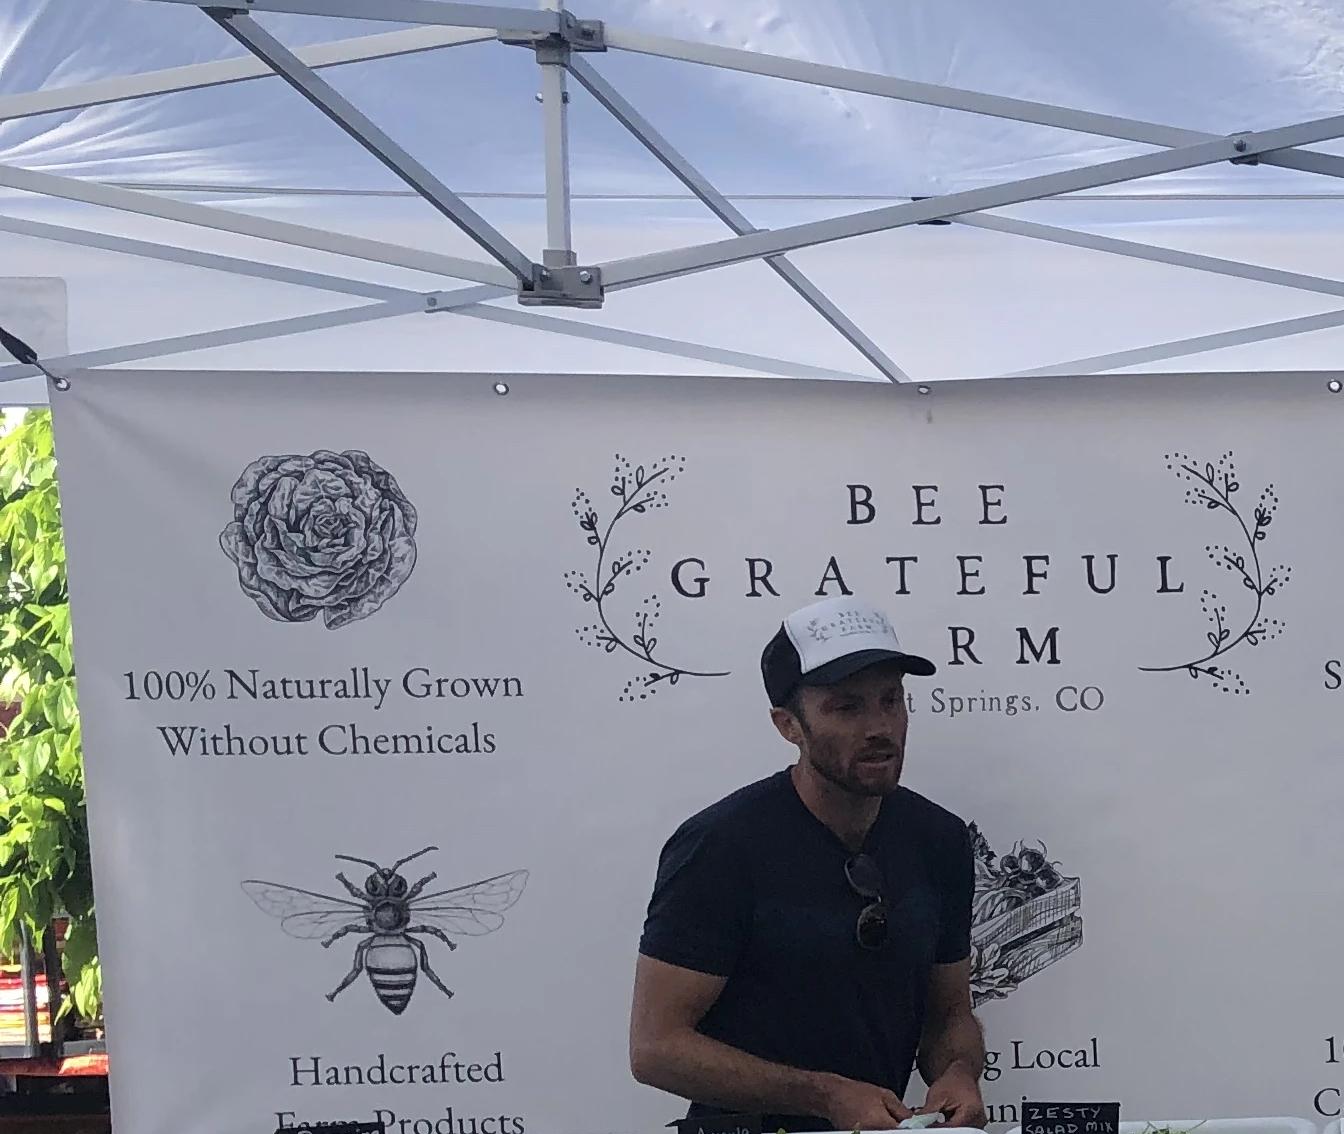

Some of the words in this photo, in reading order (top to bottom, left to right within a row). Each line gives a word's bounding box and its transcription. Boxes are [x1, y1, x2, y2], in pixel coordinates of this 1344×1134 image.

[846, 484, 1008, 526] BEE
[670, 553, 1185, 598] GRATEFUL
[947, 626, 1061, 666] RM
[123, 669, 216, 702] 100%
[223, 666, 392, 711] Naturally
[402, 667, 524, 700] Grown
[1055, 685, 1105, 712] CO
[156, 723, 309, 757] Without
[318, 721, 496, 757] Chemicals
[289, 1051, 505, 1086] Handcrafted
[1010, 1037, 1101, 1070] Local
[1028, 1106, 1101, 1120] ZESTY
[1085, 1121, 1114, 1133] MIX
